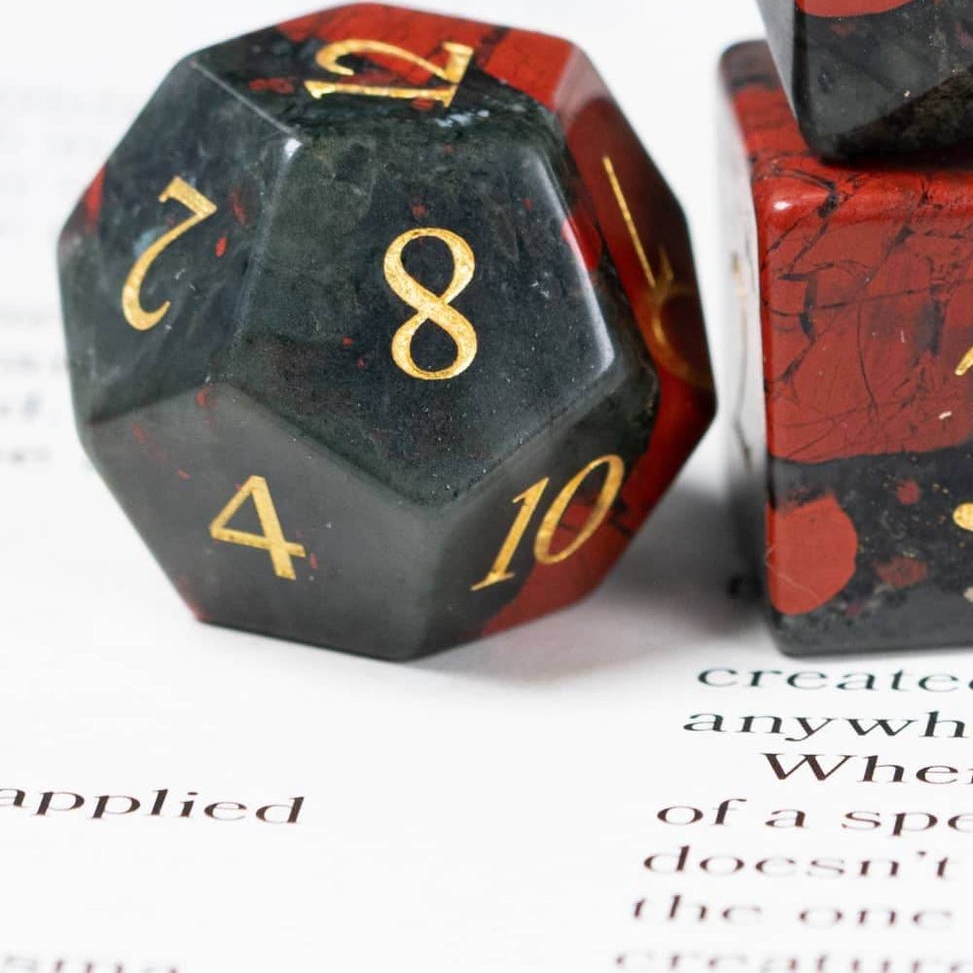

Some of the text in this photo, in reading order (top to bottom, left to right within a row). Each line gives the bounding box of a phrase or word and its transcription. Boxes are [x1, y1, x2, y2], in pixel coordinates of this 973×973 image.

[303, 37, 475, 108] 12
[120, 175, 218, 331] 2
[383, 227, 478, 381] 8
[209, 475, 307, 581] 4
[471, 454, 625, 592] 10
[0, 788, 305, 825] applied
[656, 798, 748, 826] of
[764, 809, 807, 829] a
[642, 845, 952, 881] doesn't
[632, 892, 763, 923] the
[797, 906, 953, 928] one
